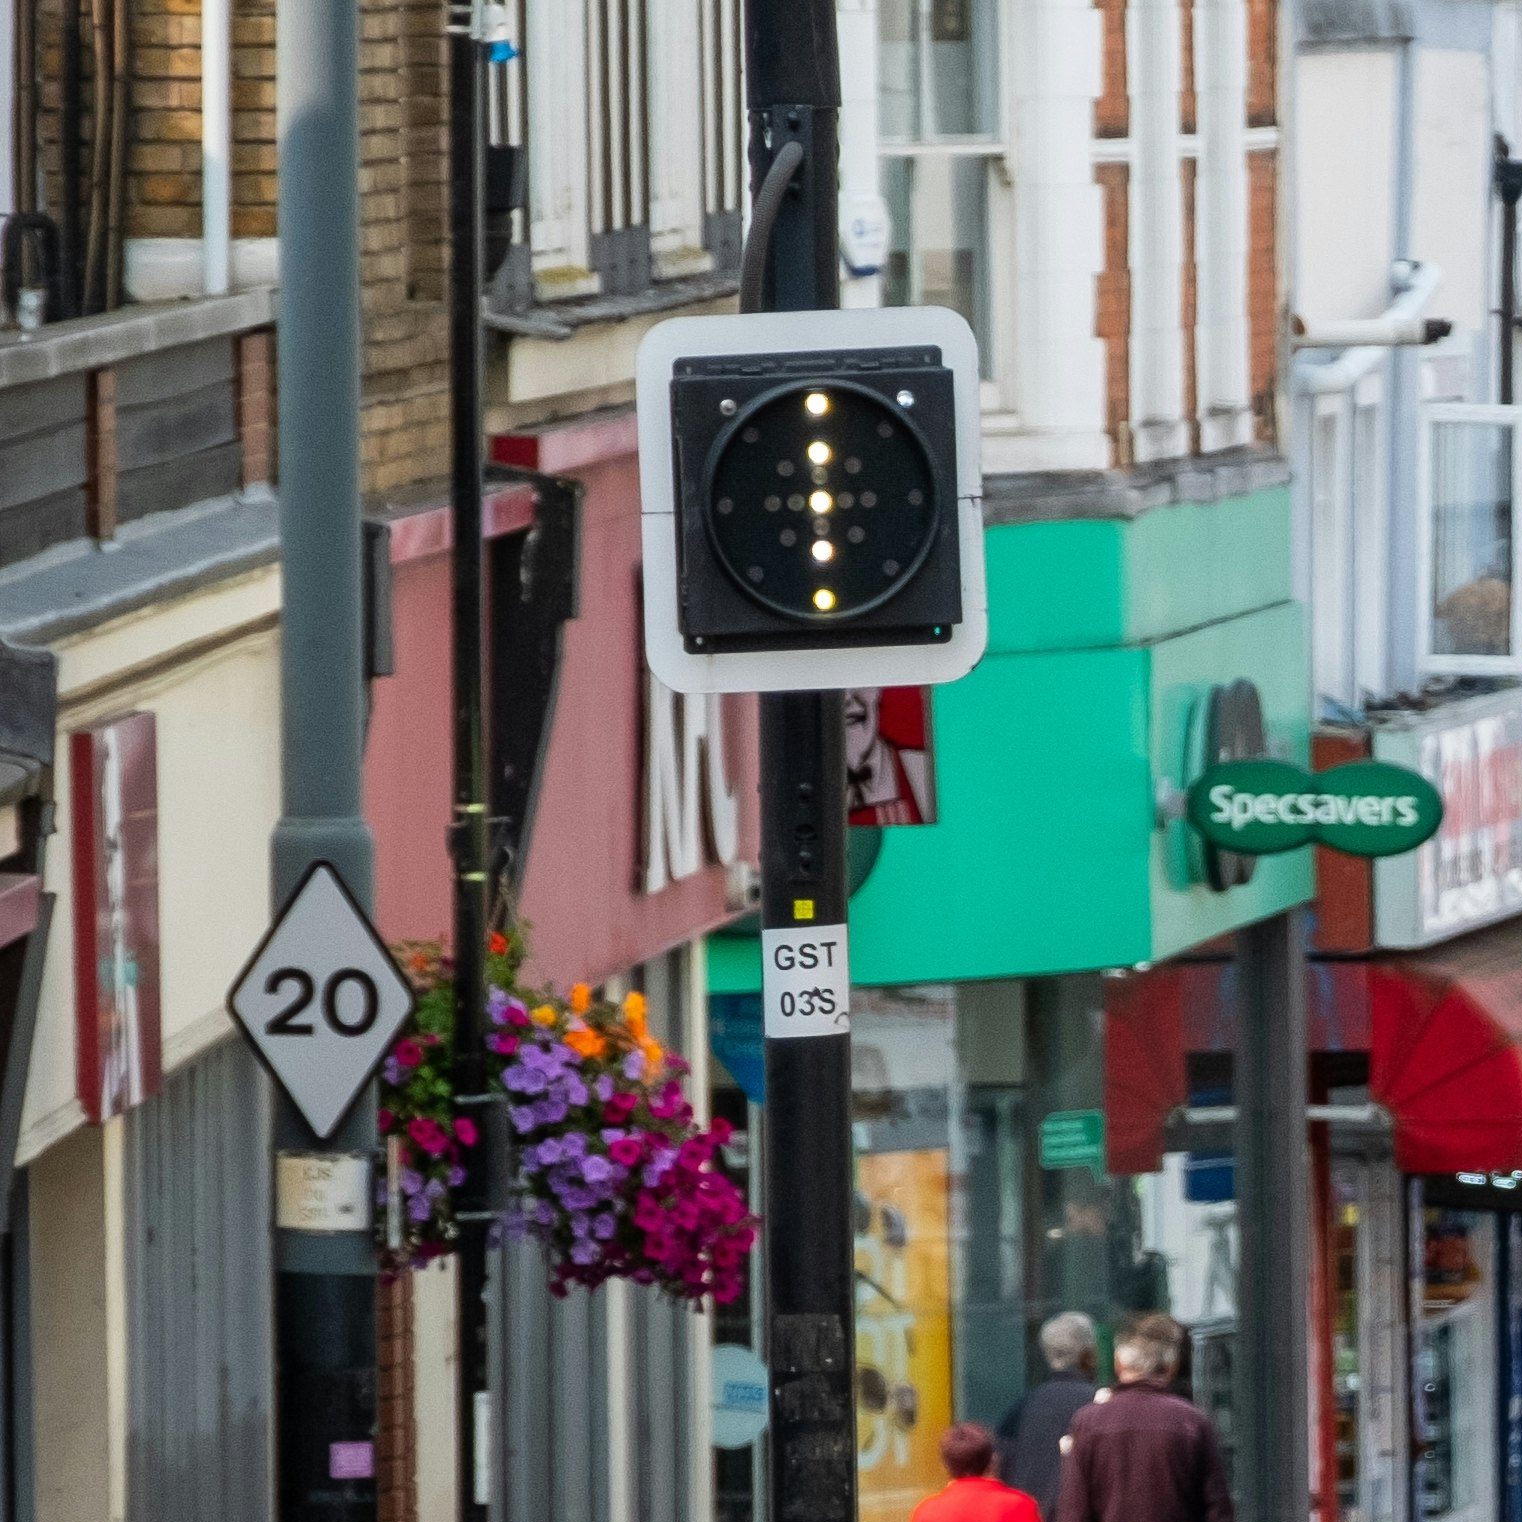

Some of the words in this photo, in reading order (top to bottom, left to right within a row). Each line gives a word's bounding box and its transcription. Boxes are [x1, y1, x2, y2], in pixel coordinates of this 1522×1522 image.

[1209, 784, 1420, 831] Specsavers
[774, 941, 837, 970] GST
[264, 966, 379, 1039] 20
